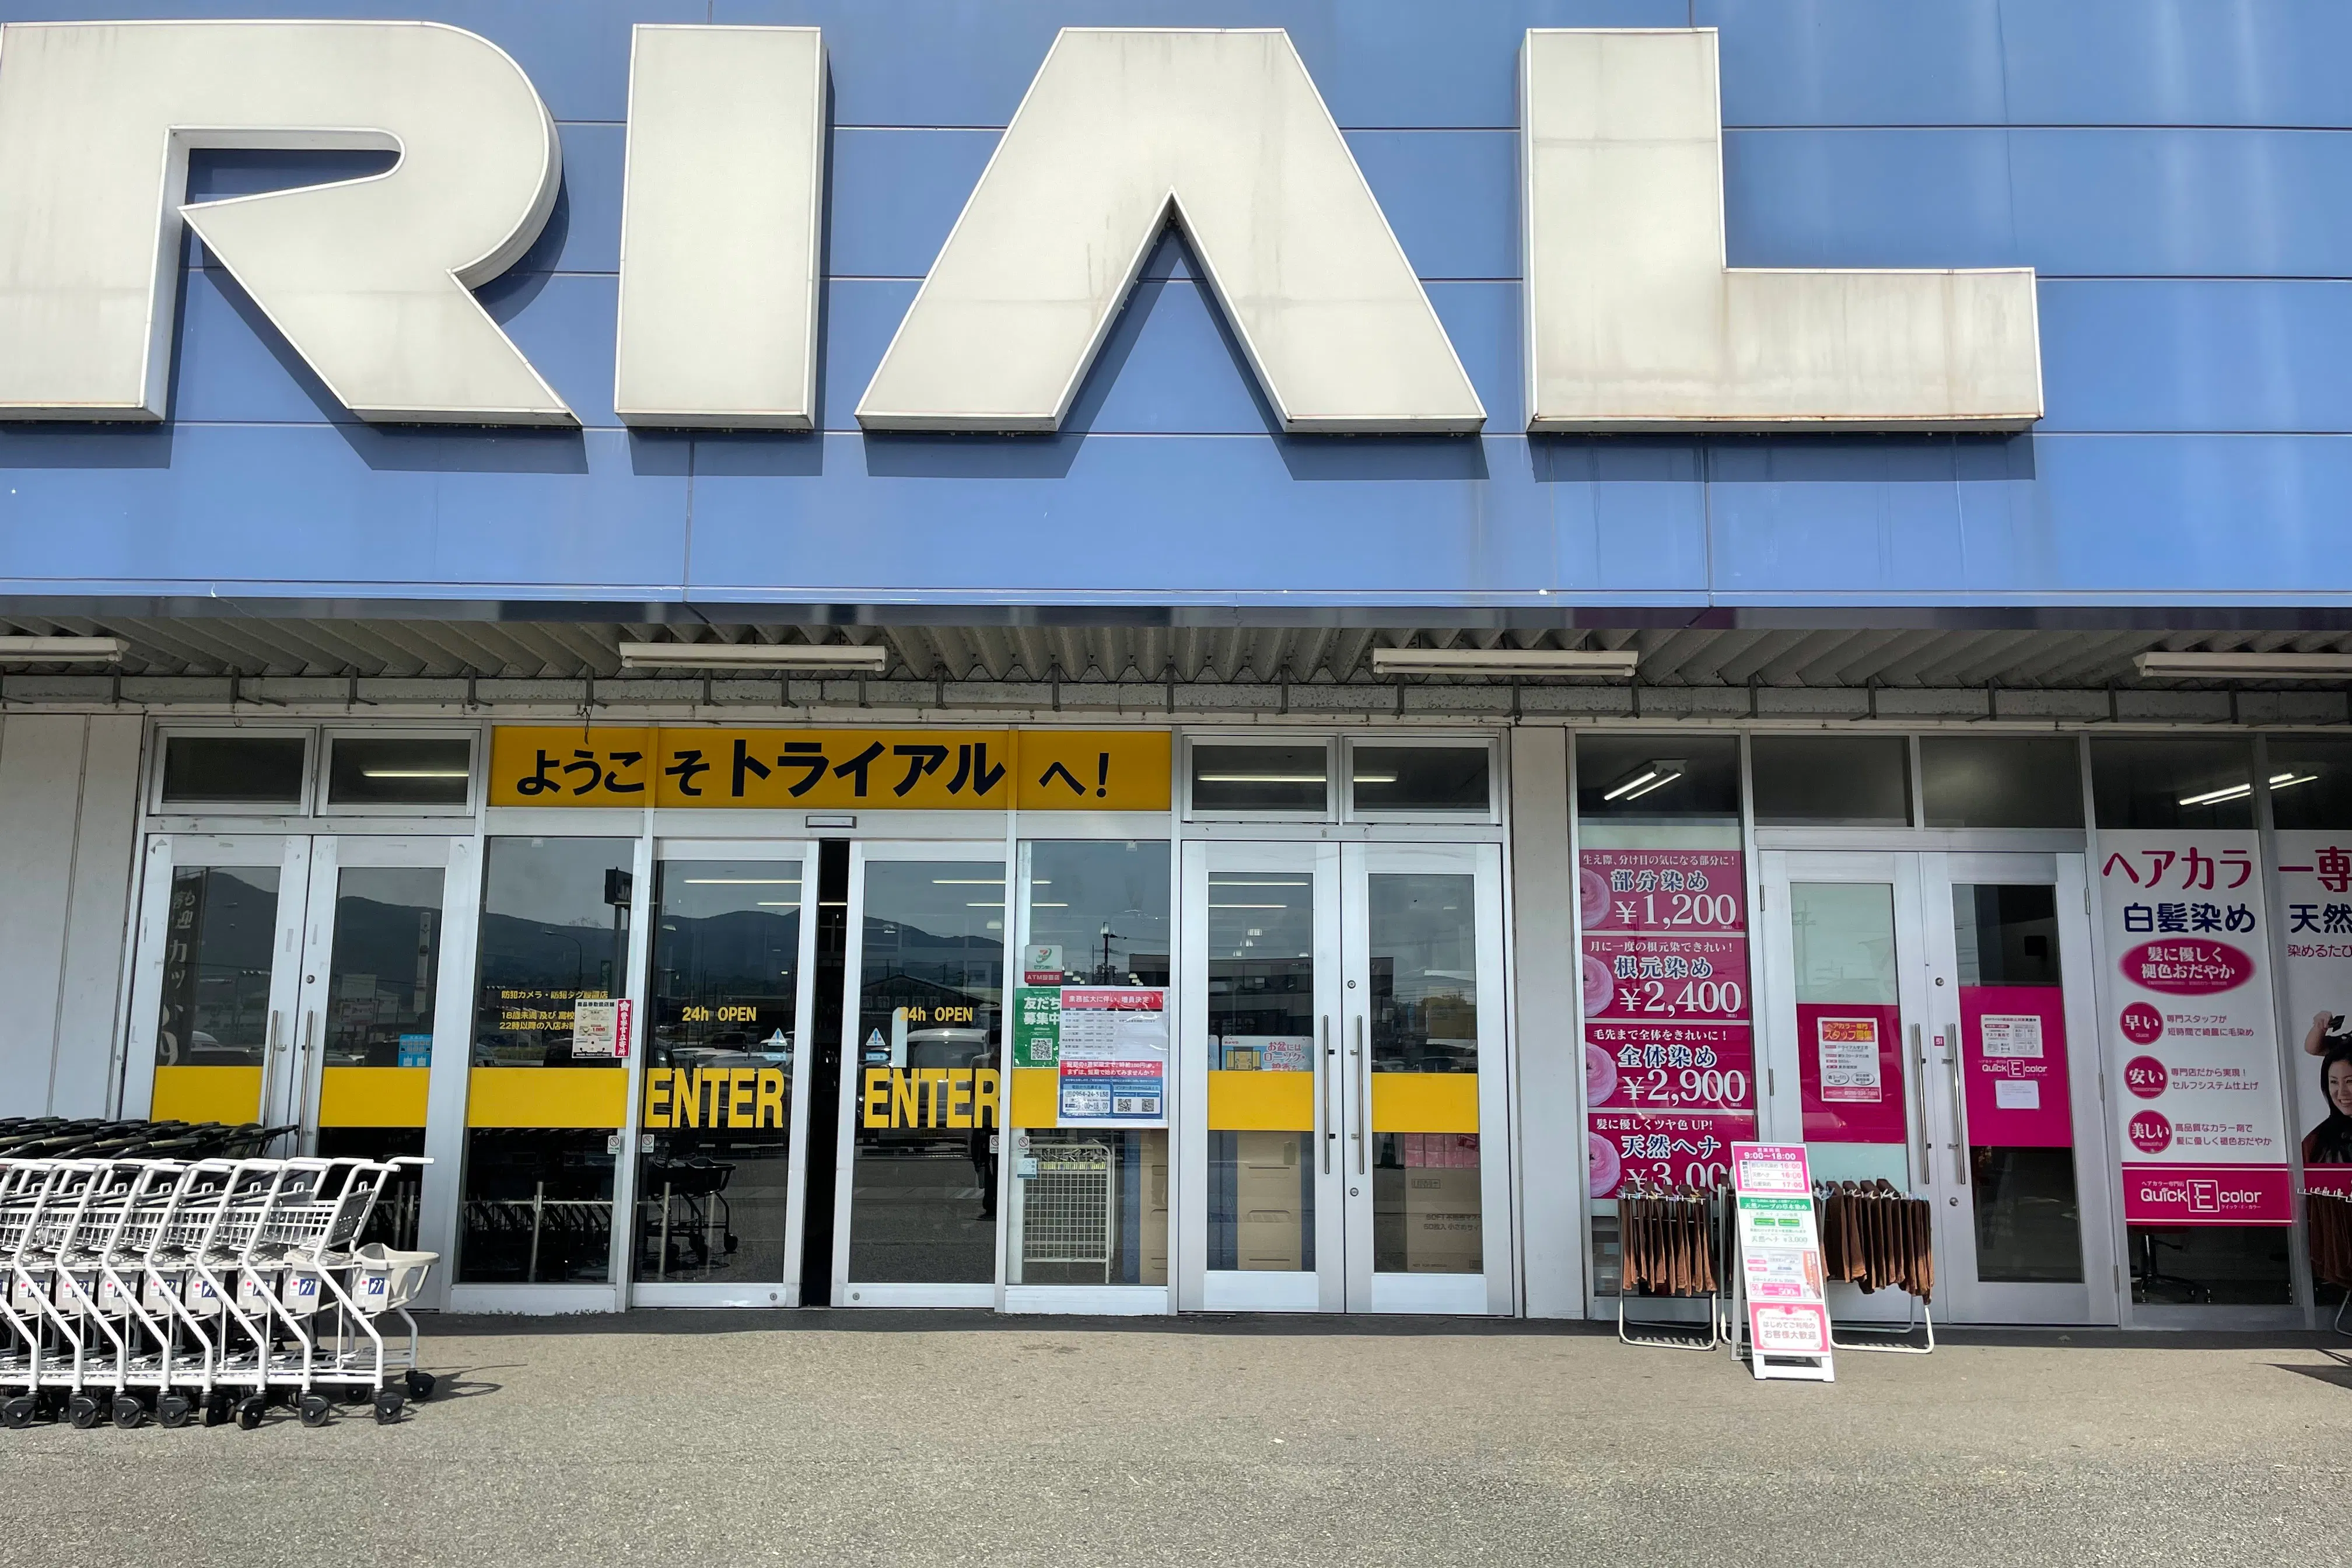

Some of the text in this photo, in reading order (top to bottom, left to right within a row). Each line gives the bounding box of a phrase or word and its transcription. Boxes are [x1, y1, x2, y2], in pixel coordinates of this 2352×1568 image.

[0, 20, 2044, 429] RIAL
[1611, 869, 1709, 892] 部分染め
[1615, 894, 1737, 930] ¥1,200
[2124, 902, 2256, 934] 白髪染め
[1590, 940, 1733, 953] 月に一度の根元染できれい！
[2147, 946, 2222, 963] 髪に優しく
[1614, 955, 1714, 980] 根元染め
[1024, 996, 1060, 1010] 友だち
[1619, 981, 1742, 1017] ¥2,400
[682, 1006, 757, 1021] 24h OPEN
[900, 1006, 973, 1022] 24h OPEN
[1023, 1012, 1060, 1025] 募集中
[2166, 1014, 2227, 1024] 専門スタッフが
[2124, 1015, 2159, 1031] 早い
[1593, 1028, 1727, 1041] 毛先まで全体をきれいに！
[2167, 1027, 2254, 1037] 短時間で綺麗に毛染め
[1267, 1041, 1302, 1052] お盆には
[1618, 1044, 1717, 1069] 全体染め
[1982, 1063, 2007, 1072] Quick
[2025, 1065, 2048, 1073] color
[2129, 1068, 2164, 1085] 安い
[2171, 1068, 2246, 1077] 専門店だから実現！
[1622, 1069, 1746, 1106] ¥2,900
[2172, 1081, 2259, 1090] セルフシステム仕上げ
[645, 1068, 785, 1128] ENTER
[863, 1068, 1001, 1129] ENTER
[2132, 1122, 2169, 1139] 美しい
[2175, 1124, 2253, 1133] 高品質なカラー剤で
[1620, 1134, 1721, 1160] 天然ヘナ
[2140, 1186, 2188, 1203] Quick
[2220, 1189, 2262, 1203] color
